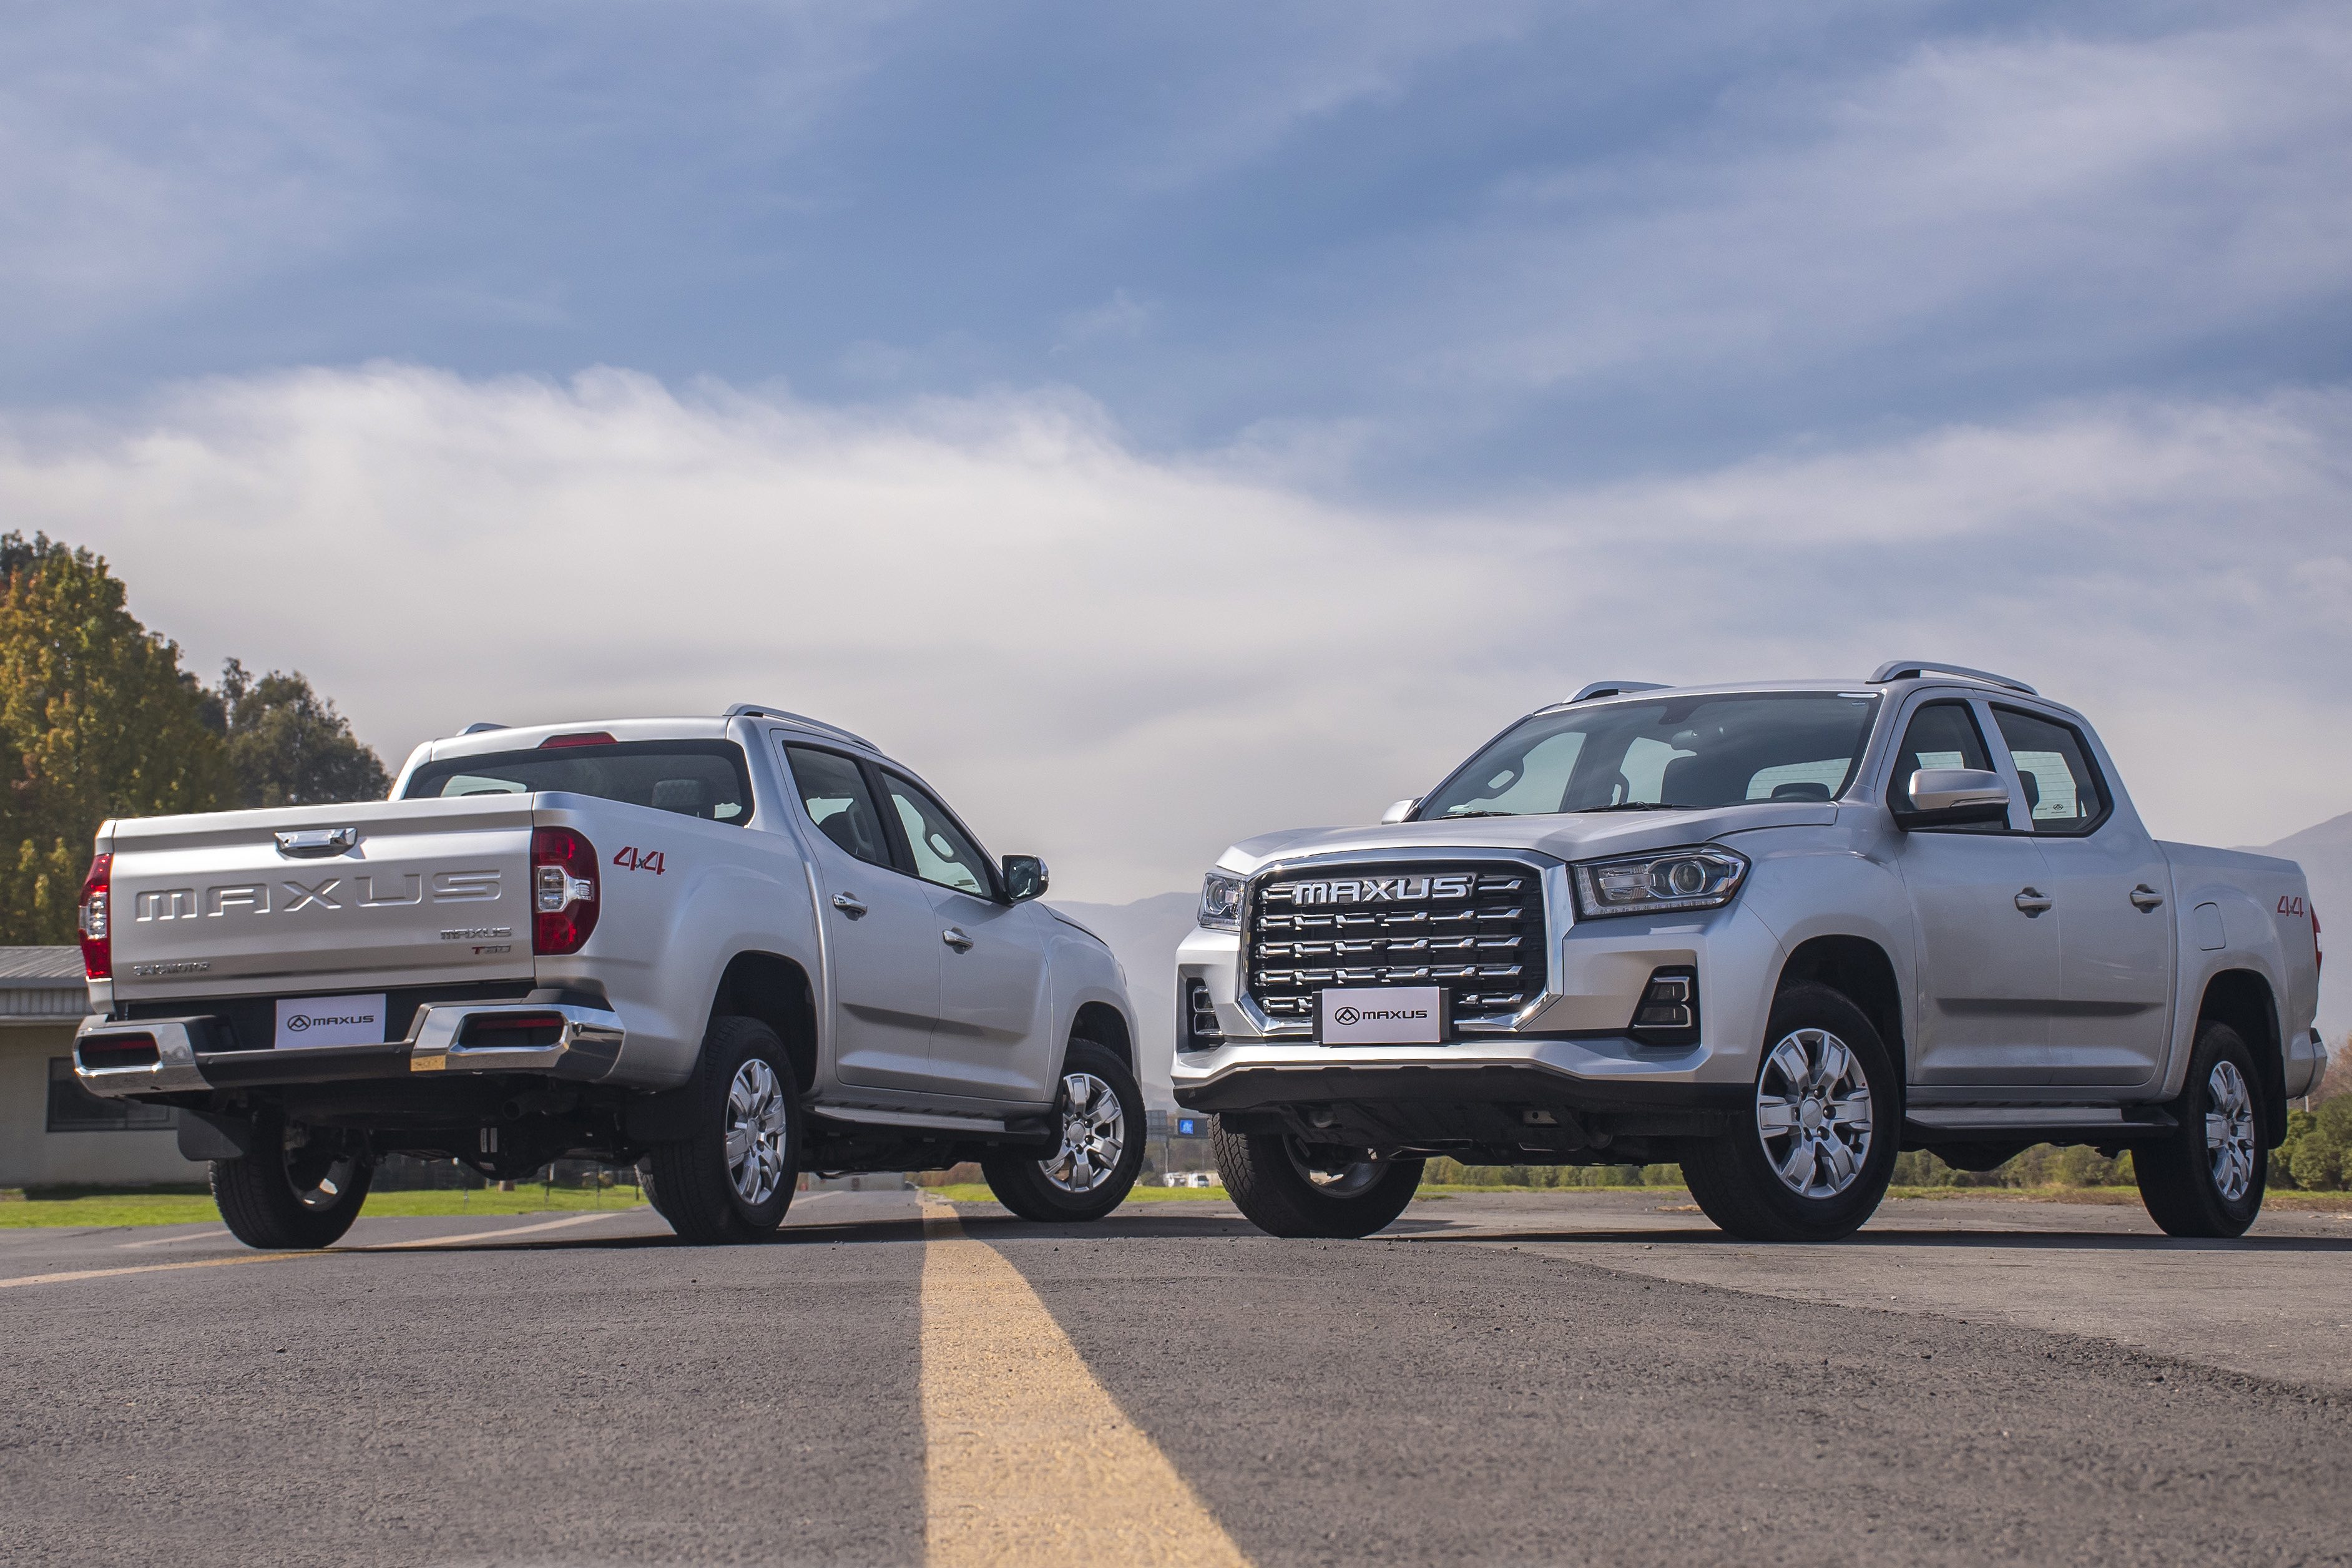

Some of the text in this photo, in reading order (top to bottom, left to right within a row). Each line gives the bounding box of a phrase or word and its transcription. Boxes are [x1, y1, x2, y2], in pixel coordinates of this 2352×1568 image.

[613, 846, 666, 875] 4x4
[135, 870, 502, 921] MAXUS
[1295, 876, 1474, 905] MAXUS
[2277, 896, 2305, 918] 4x4
[441, 927, 512, 939] MAXUS
[313, 1015, 375, 1026] MAXUS
[1363, 1010, 1428, 1020] MAXUS
